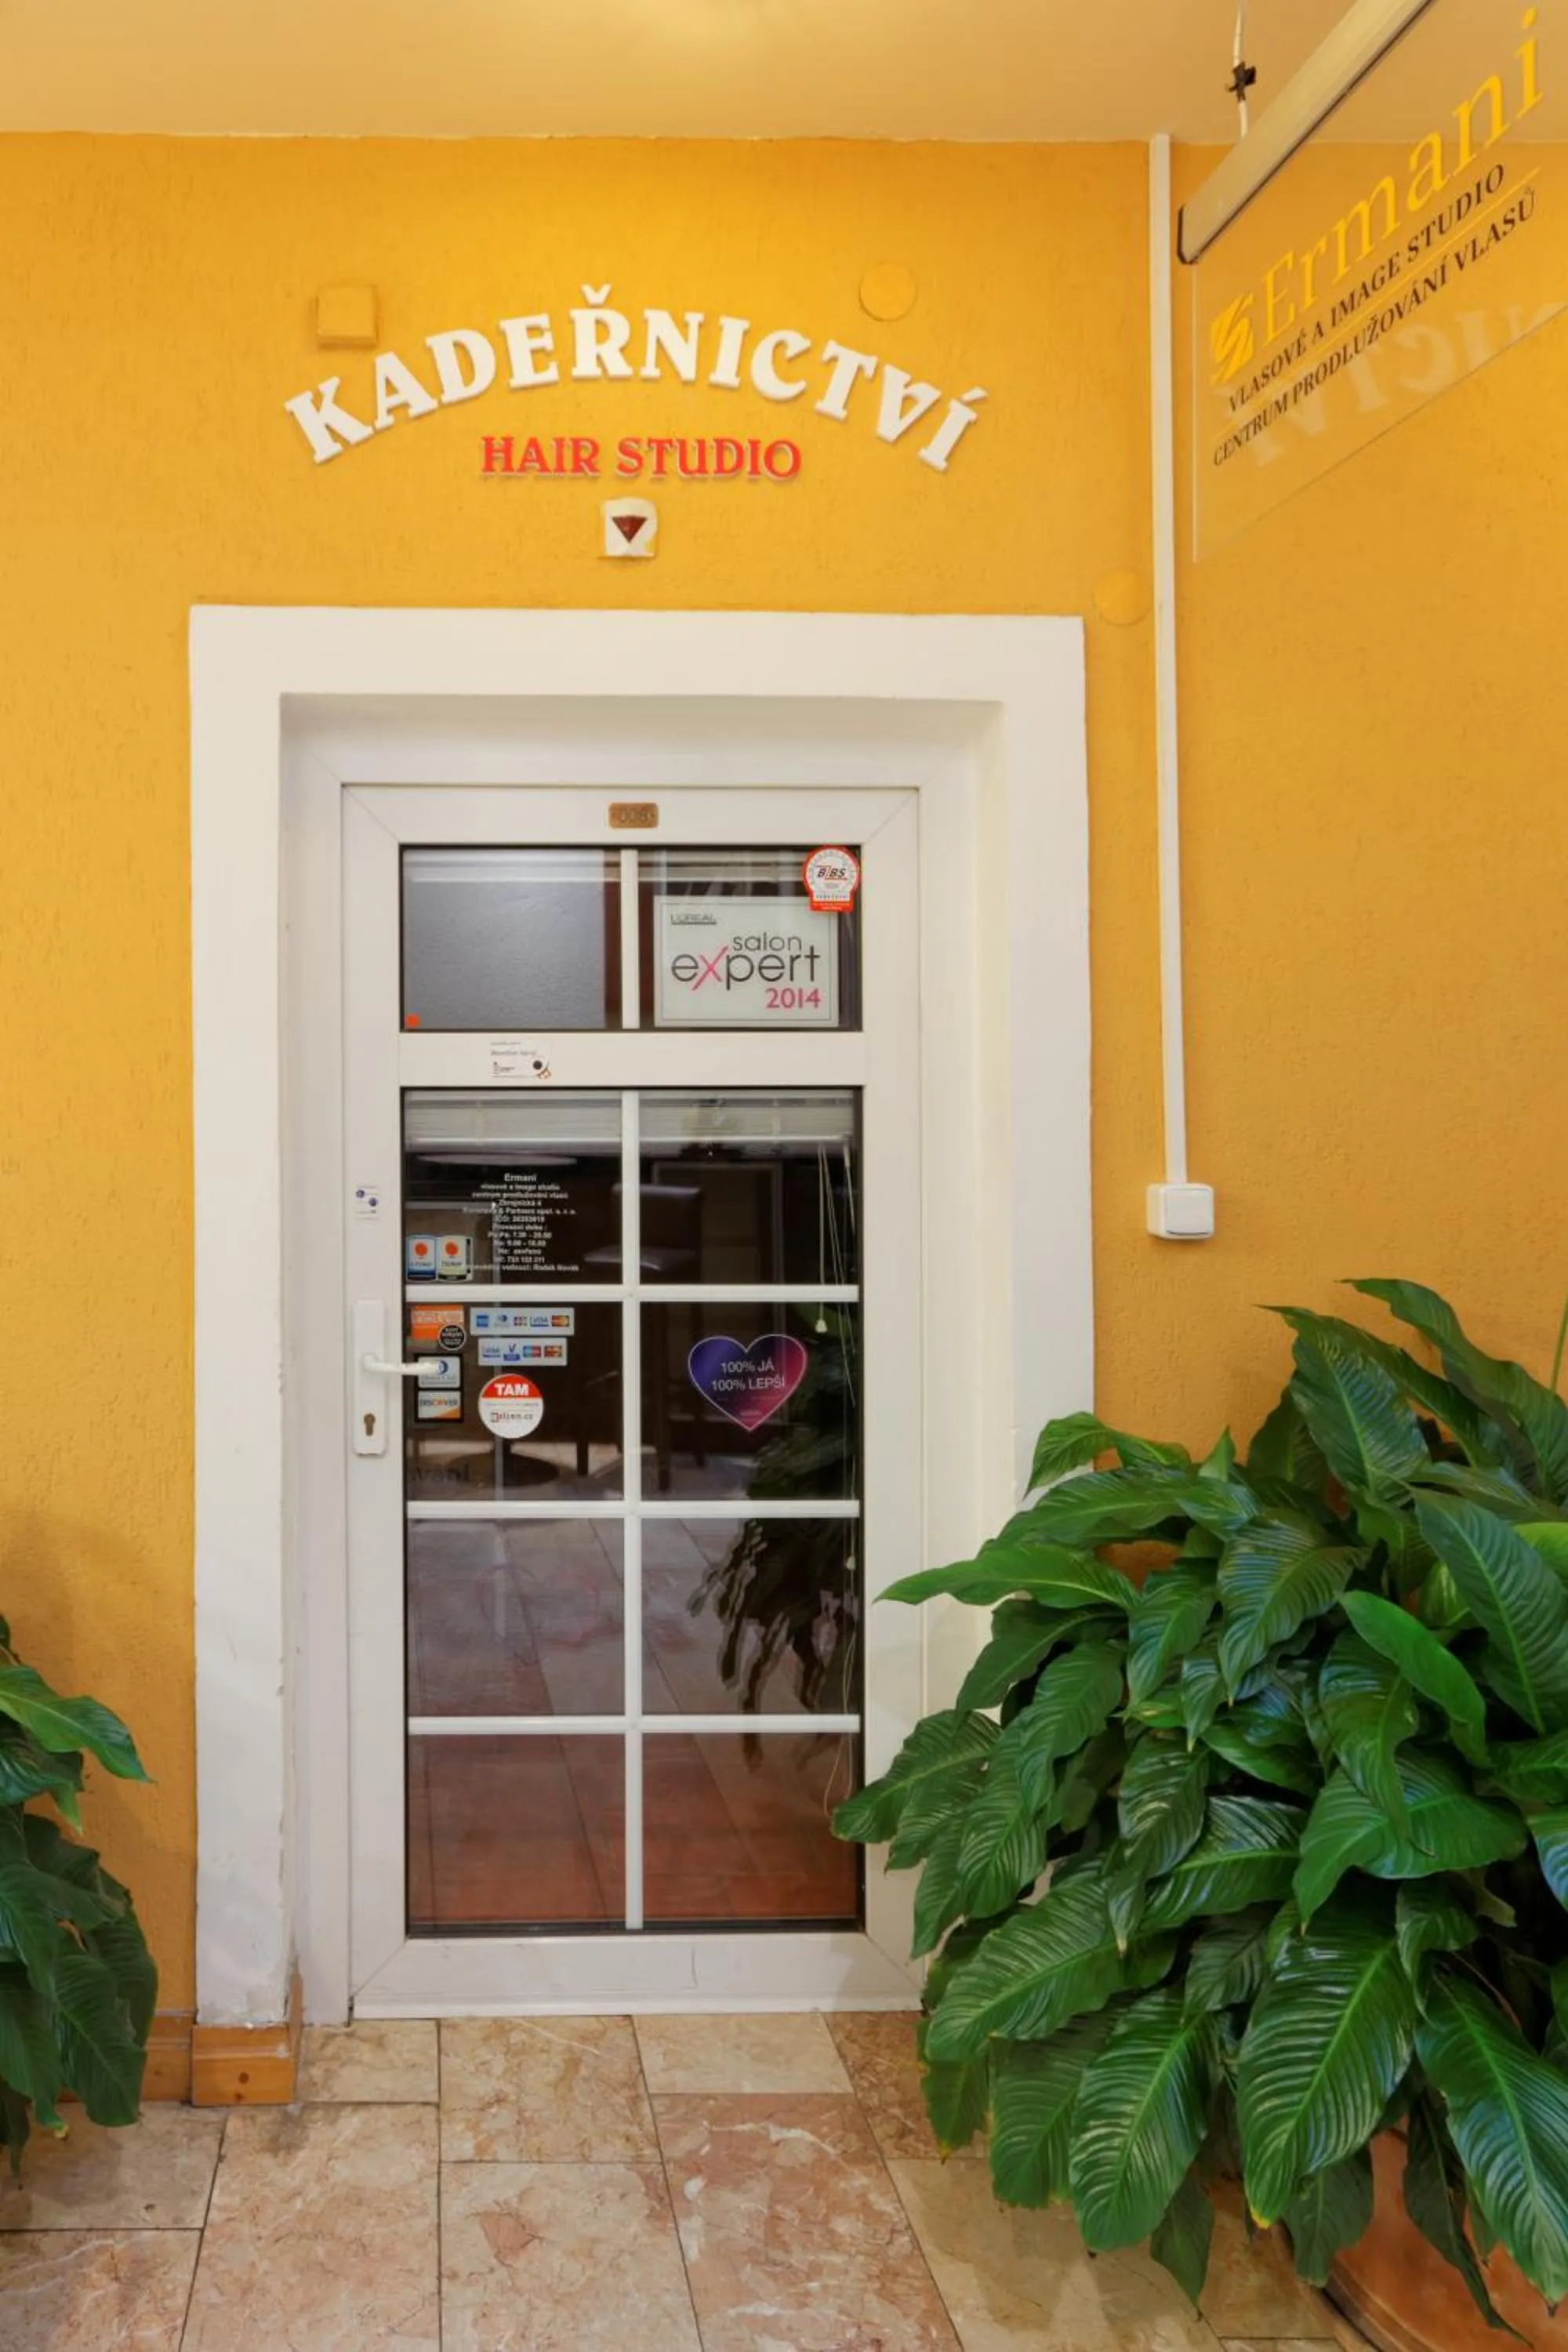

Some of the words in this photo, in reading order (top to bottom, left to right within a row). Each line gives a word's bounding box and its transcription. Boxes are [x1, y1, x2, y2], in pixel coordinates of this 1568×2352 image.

[1261, 7, 1544, 345] Ermani
[1227, 330, 1308, 413] VLASOVÉ
[1312, 320, 1325, 343] A
[1330, 251, 1401, 328] IMAGE
[1406, 163, 1504, 263] STUDIO
[1213, 399, 1289, 467] CENTRUM
[1291, 253, 1451, 405] PRODLUŽOVÁNÍ
[1454, 187, 1536, 275] VLASŮ
[284, 283, 988, 472] KADEŘNICTVÍ
[481, 436, 601, 480] HAIR
[615, 437, 803, 482] STUDIO
[732, 932, 802, 951] salon
[671, 945, 821, 992] expert
[765, 988, 822, 1009] 2014
[504, 1173, 537, 1181] Ermani
[720, 1361, 755, 1374] 100%
[757, 1357, 775, 1372] JÁ
[495, 1383, 529, 1396] TAM
[712, 1377, 746, 1392] 100%
